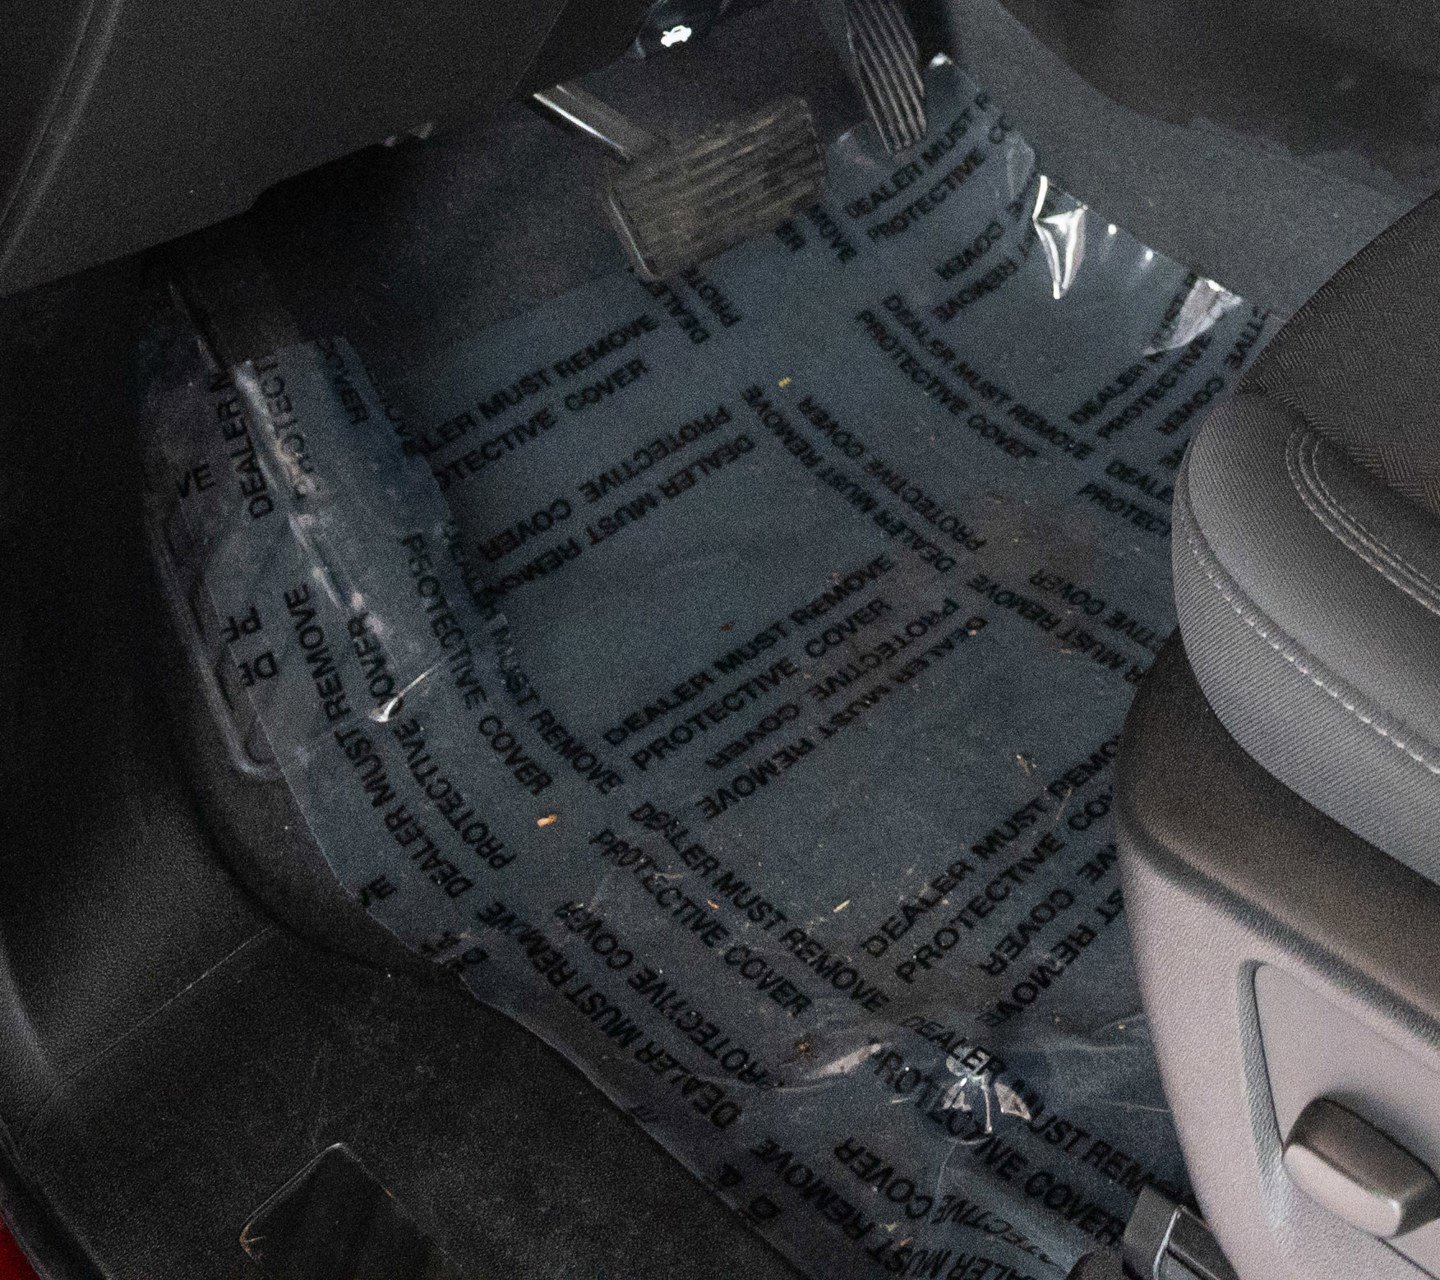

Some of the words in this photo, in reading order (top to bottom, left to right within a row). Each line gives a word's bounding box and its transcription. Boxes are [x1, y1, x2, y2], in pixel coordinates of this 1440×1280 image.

[845, 161, 927, 219] DEALER
[920, 107, 975, 163] MUST
[867, 147, 988, 239] PROTECTIVE
[478, 370, 554, 419] MUST
[553, 314, 660, 377] REMOVE
[563, 355, 651, 413] COVER
[858, 308, 970, 416] PROTECTIVE
[578, 403, 734, 504] PROTECTIVE
[660, 432, 757, 501] DEALER
[740, 385, 825, 469] REMOVE
[798, 394, 864, 458] COVER
[478, 497, 574, 563] COVER
[583, 492, 658, 546] MUST
[819, 464, 878, 514] MUST
[283, 582, 353, 724] REMOVE
[403, 533, 489, 710] PROTECTIVE
[478, 713, 554, 797] COVER
[605, 669, 713, 745] DEALER
[713, 621, 793, 675] MUST
[789, 552, 896, 627] REMOVE
[631, 656, 799, 771] PROTECTIVE
[804, 598, 891, 660] COVER
[333, 726, 398, 808] MUST
[530, 708, 624, 796] REMOVE
[696, 737, 817, 820] REMOVE
[706, 702, 802, 771] COVER
[393, 716, 517, 872] PROTECTIVE
[383, 806, 474, 899] DEALER
[860, 858, 977, 960] DEALER
[970, 797, 1048, 861] MUST
[714, 870, 788, 931] MUST
[781, 927, 890, 1014] REMOVE
[895, 834, 1067, 985] PROTECTIVE
[978, 887, 1076, 978] COVER
[568, 982, 637, 1047] MUST
[723, 943, 815, 1016] COVER
[633, 1035, 742, 1132] DEALER
[751, 1140, 875, 1241] REMOVE
[833, 1138, 931, 1220] COVER
[1025, 1169, 1126, 1243] COVER
